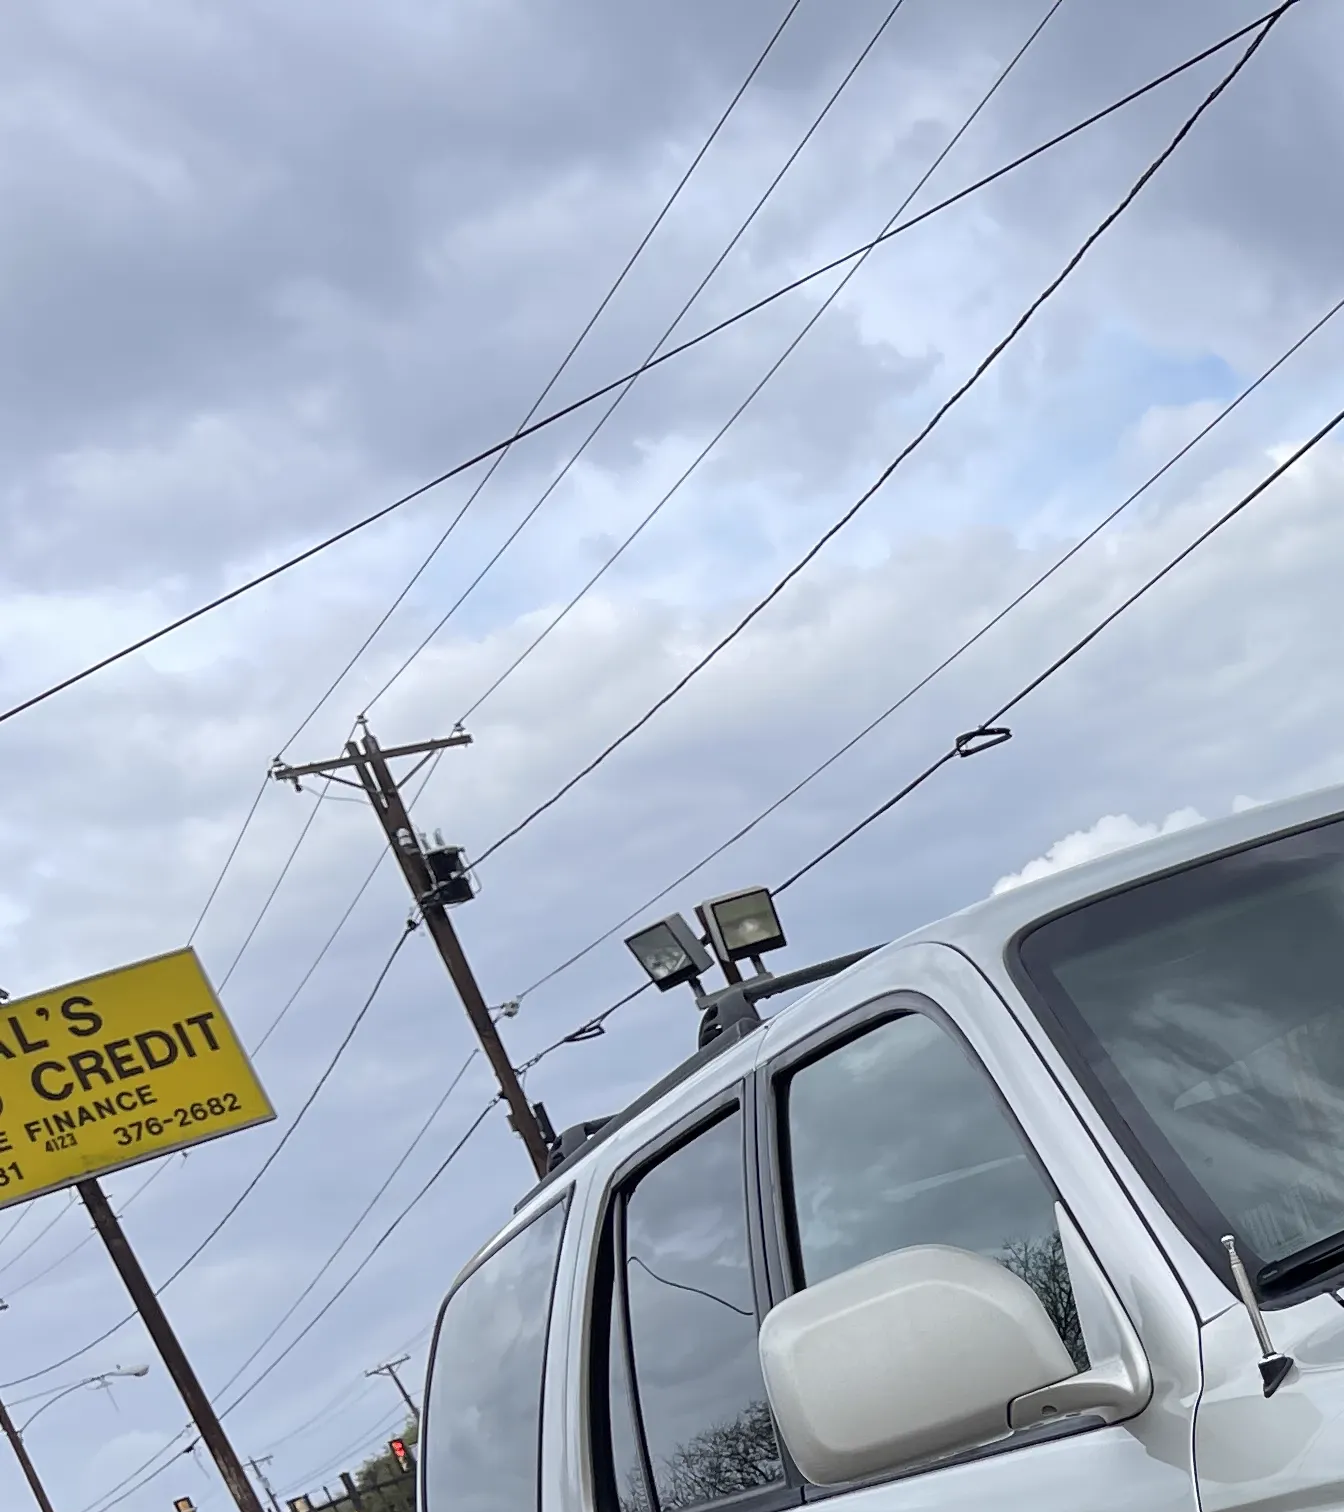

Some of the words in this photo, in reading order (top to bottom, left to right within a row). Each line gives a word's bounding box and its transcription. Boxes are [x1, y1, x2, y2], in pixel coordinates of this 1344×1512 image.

[0, 995, 104, 1060] L'S
[30, 1012, 221, 1101] CREDIT
[23, 1084, 157, 1143] FINANCE
[112, 1092, 242, 1147] 376-2682
